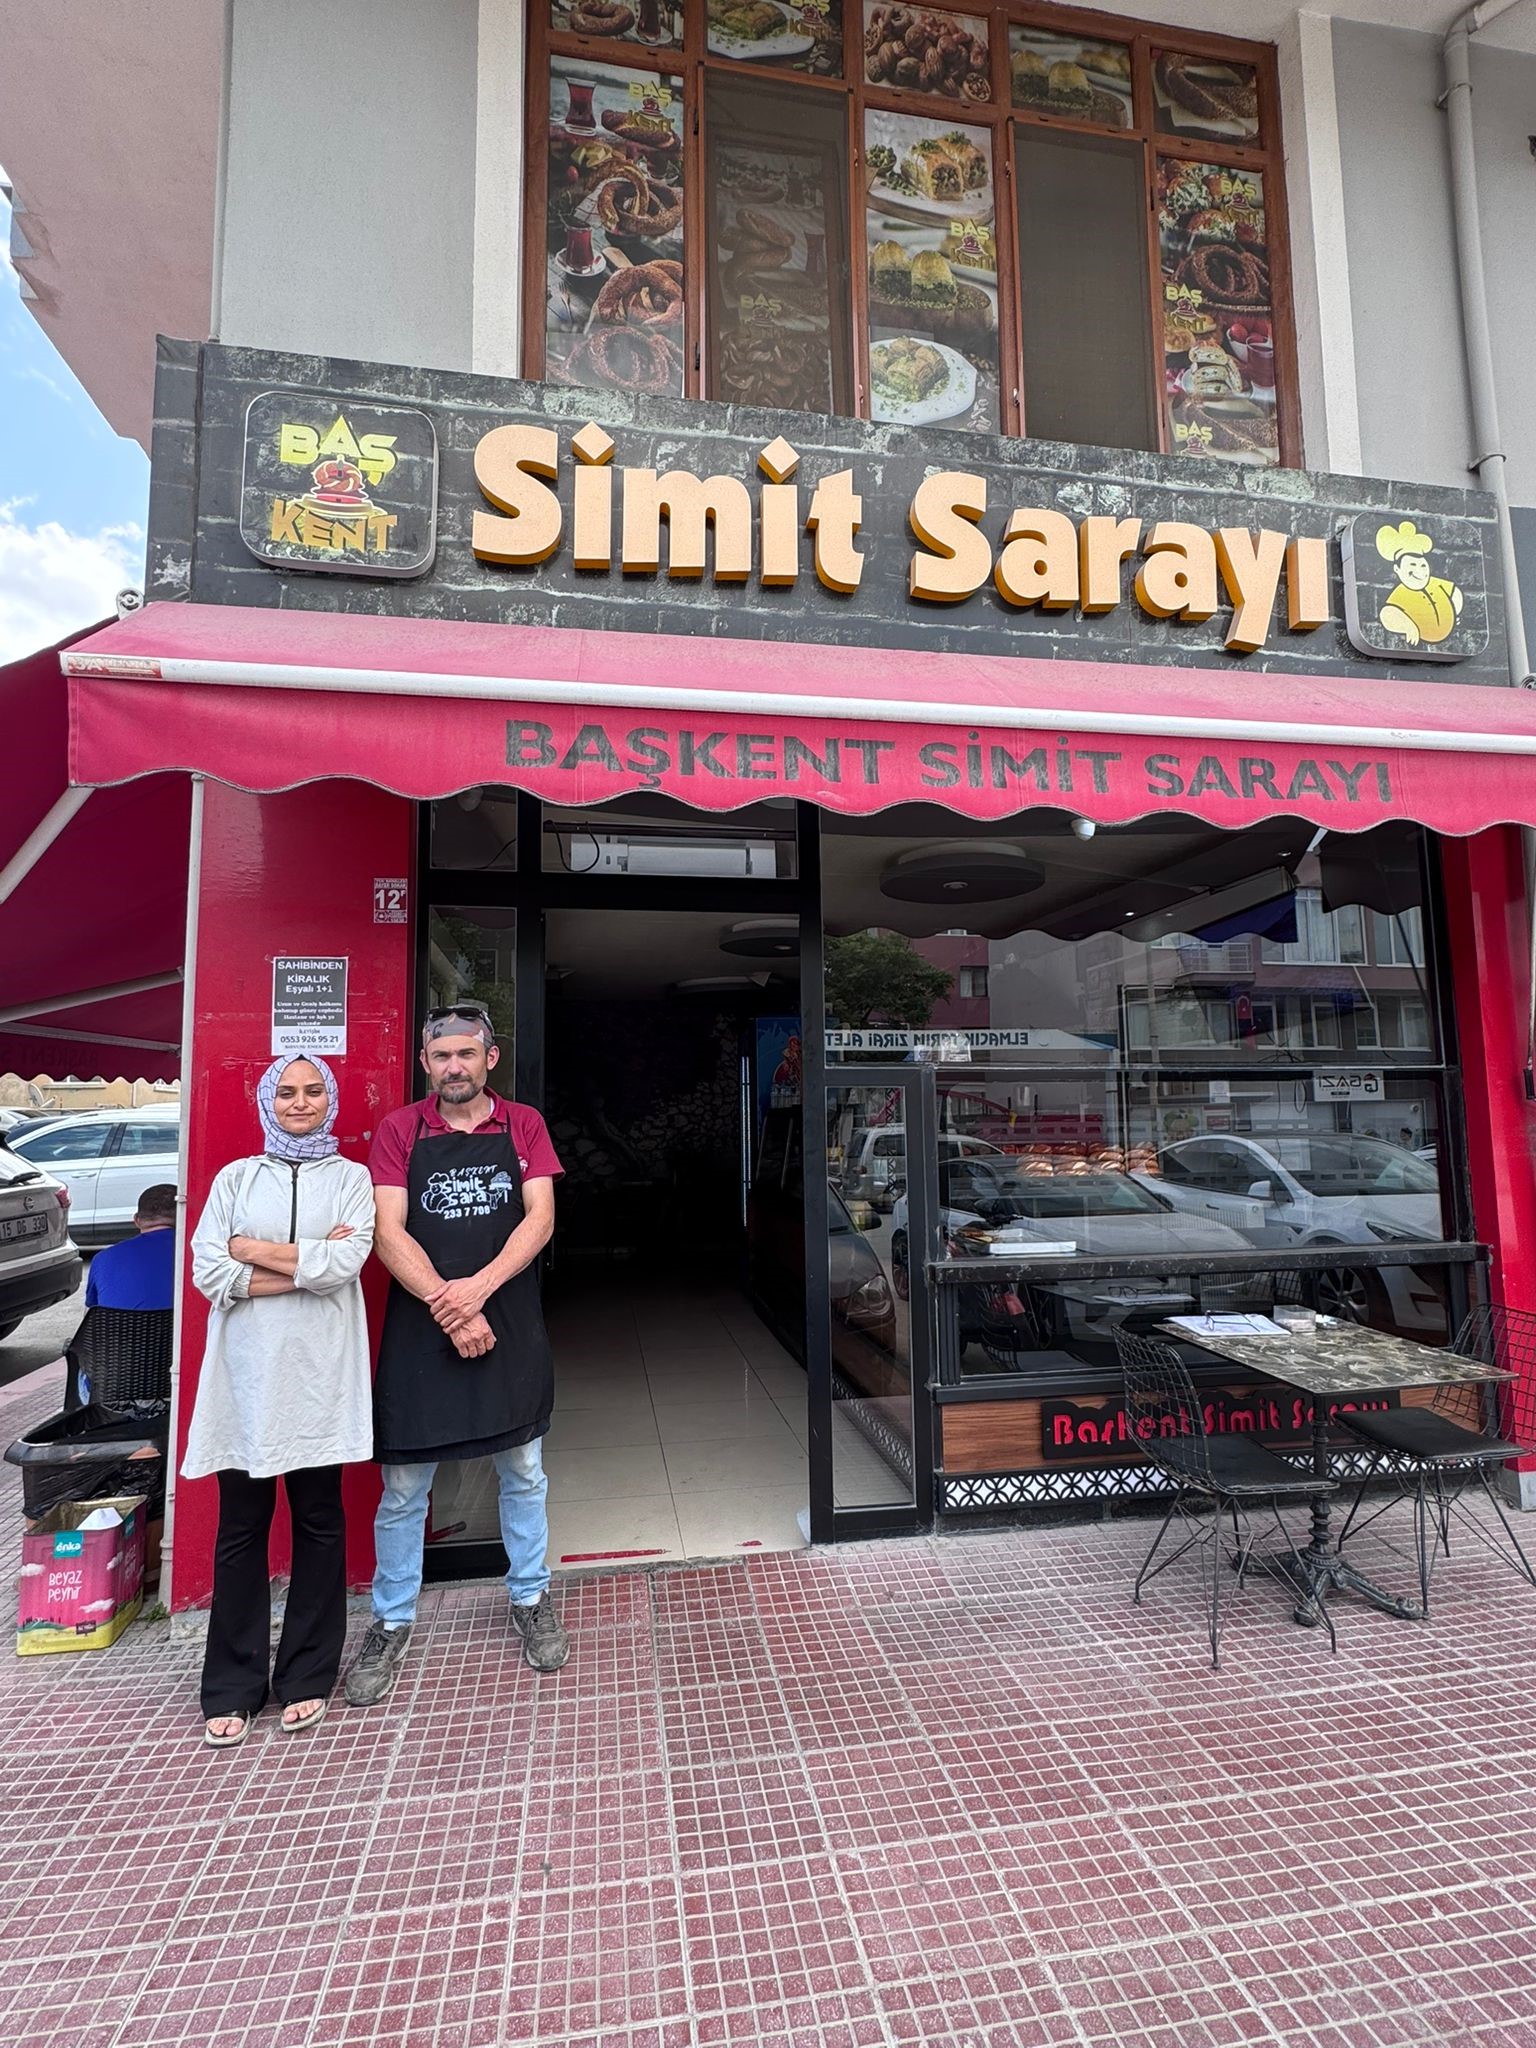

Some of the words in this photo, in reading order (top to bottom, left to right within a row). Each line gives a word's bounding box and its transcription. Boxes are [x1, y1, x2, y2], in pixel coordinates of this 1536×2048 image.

[629, 80, 673, 107] BAŞ
[1166, 283, 1203, 307] BAŞ
[1175, 420, 1213, 445] BAŞ
[280, 415, 398, 486] BAŞ
[271, 498, 398, 553] KENT
[471, 420, 865, 594] Simit
[909, 470, 1330, 652] Sarayı
[505, 719, 896, 788] BAŞKENT
[919, 731, 1122, 794] SİMİT
[1144, 754, 1393, 803] SARAYI
[277, 960, 343, 970] SAHİBİNDEN
[287, 973, 330, 983] KİRALIK
[286, 985, 314, 994] Eşyalı
[316, 985, 333, 993] 1+1
[444, 1208, 462, 1220] 233
[464, 1207, 471, 1217] 7
[1203, 1398, 1281, 1435] Simit
